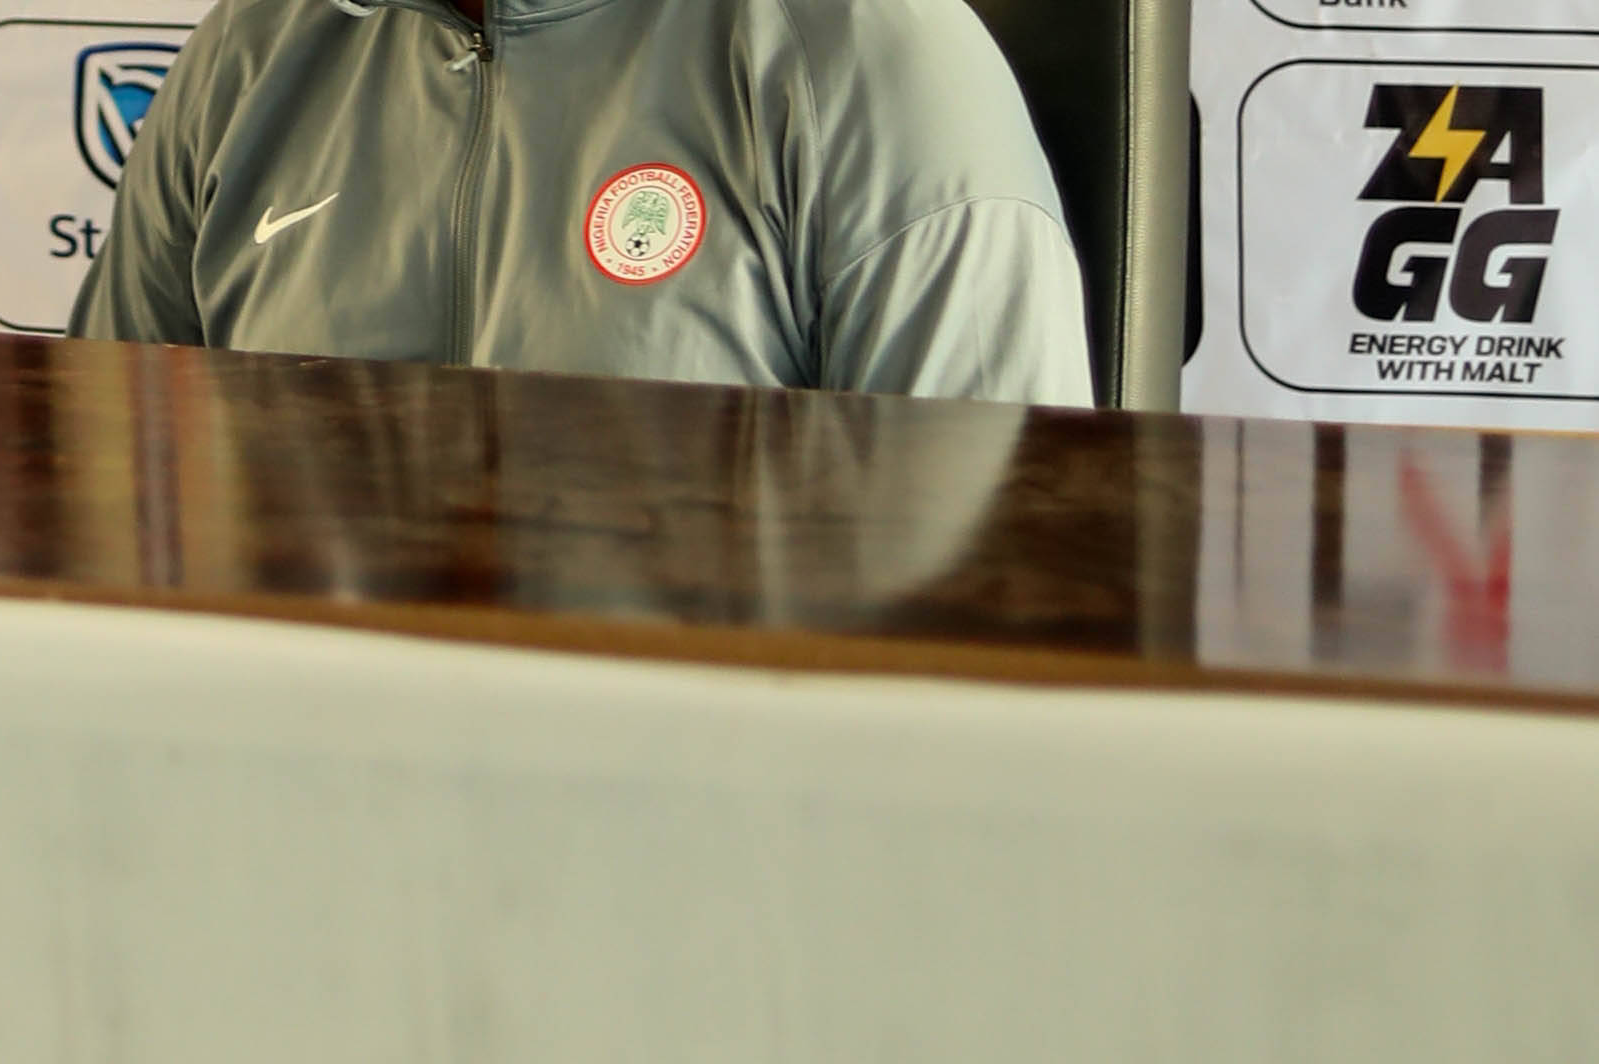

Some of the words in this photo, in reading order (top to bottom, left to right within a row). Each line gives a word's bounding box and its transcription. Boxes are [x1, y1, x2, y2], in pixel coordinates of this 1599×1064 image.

[1352, 206, 1560, 324] GG
[1349, 333, 1465, 357] ENERGY
[1475, 335, 1564, 360] DRINK
[1376, 360, 1456, 382] WITH
[1461, 361, 1542, 384] MALT
